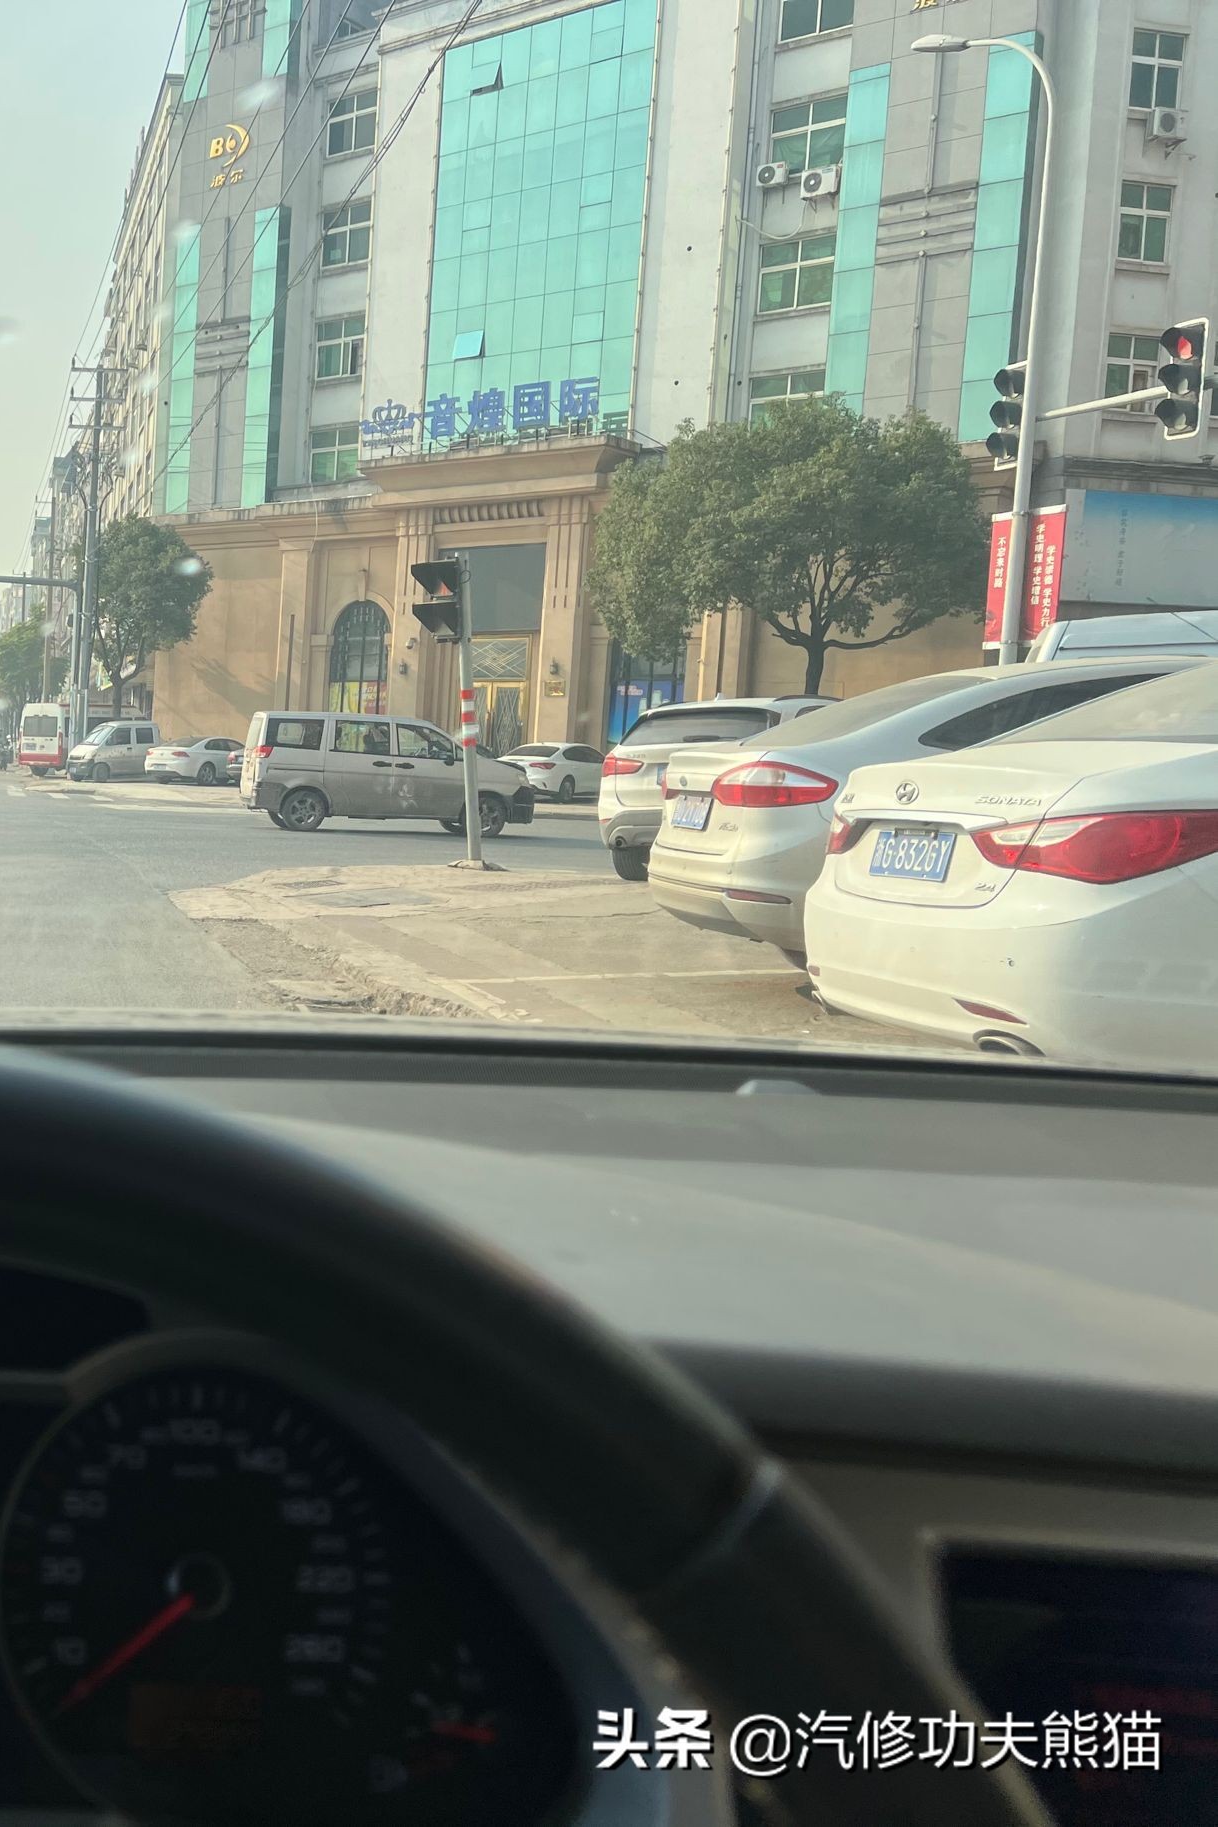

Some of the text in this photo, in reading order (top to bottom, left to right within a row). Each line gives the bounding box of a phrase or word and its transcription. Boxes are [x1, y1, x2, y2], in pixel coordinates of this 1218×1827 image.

[427, 376, 600, 440] 音煌国际
[993, 536, 1007, 588] 不忘来时路
[1030, 523, 1046, 605] 学史明理 学史增信
[1040, 545, 1056, 628] 学史崇德 学史力行
[974, 795, 1043, 807] SONATA
